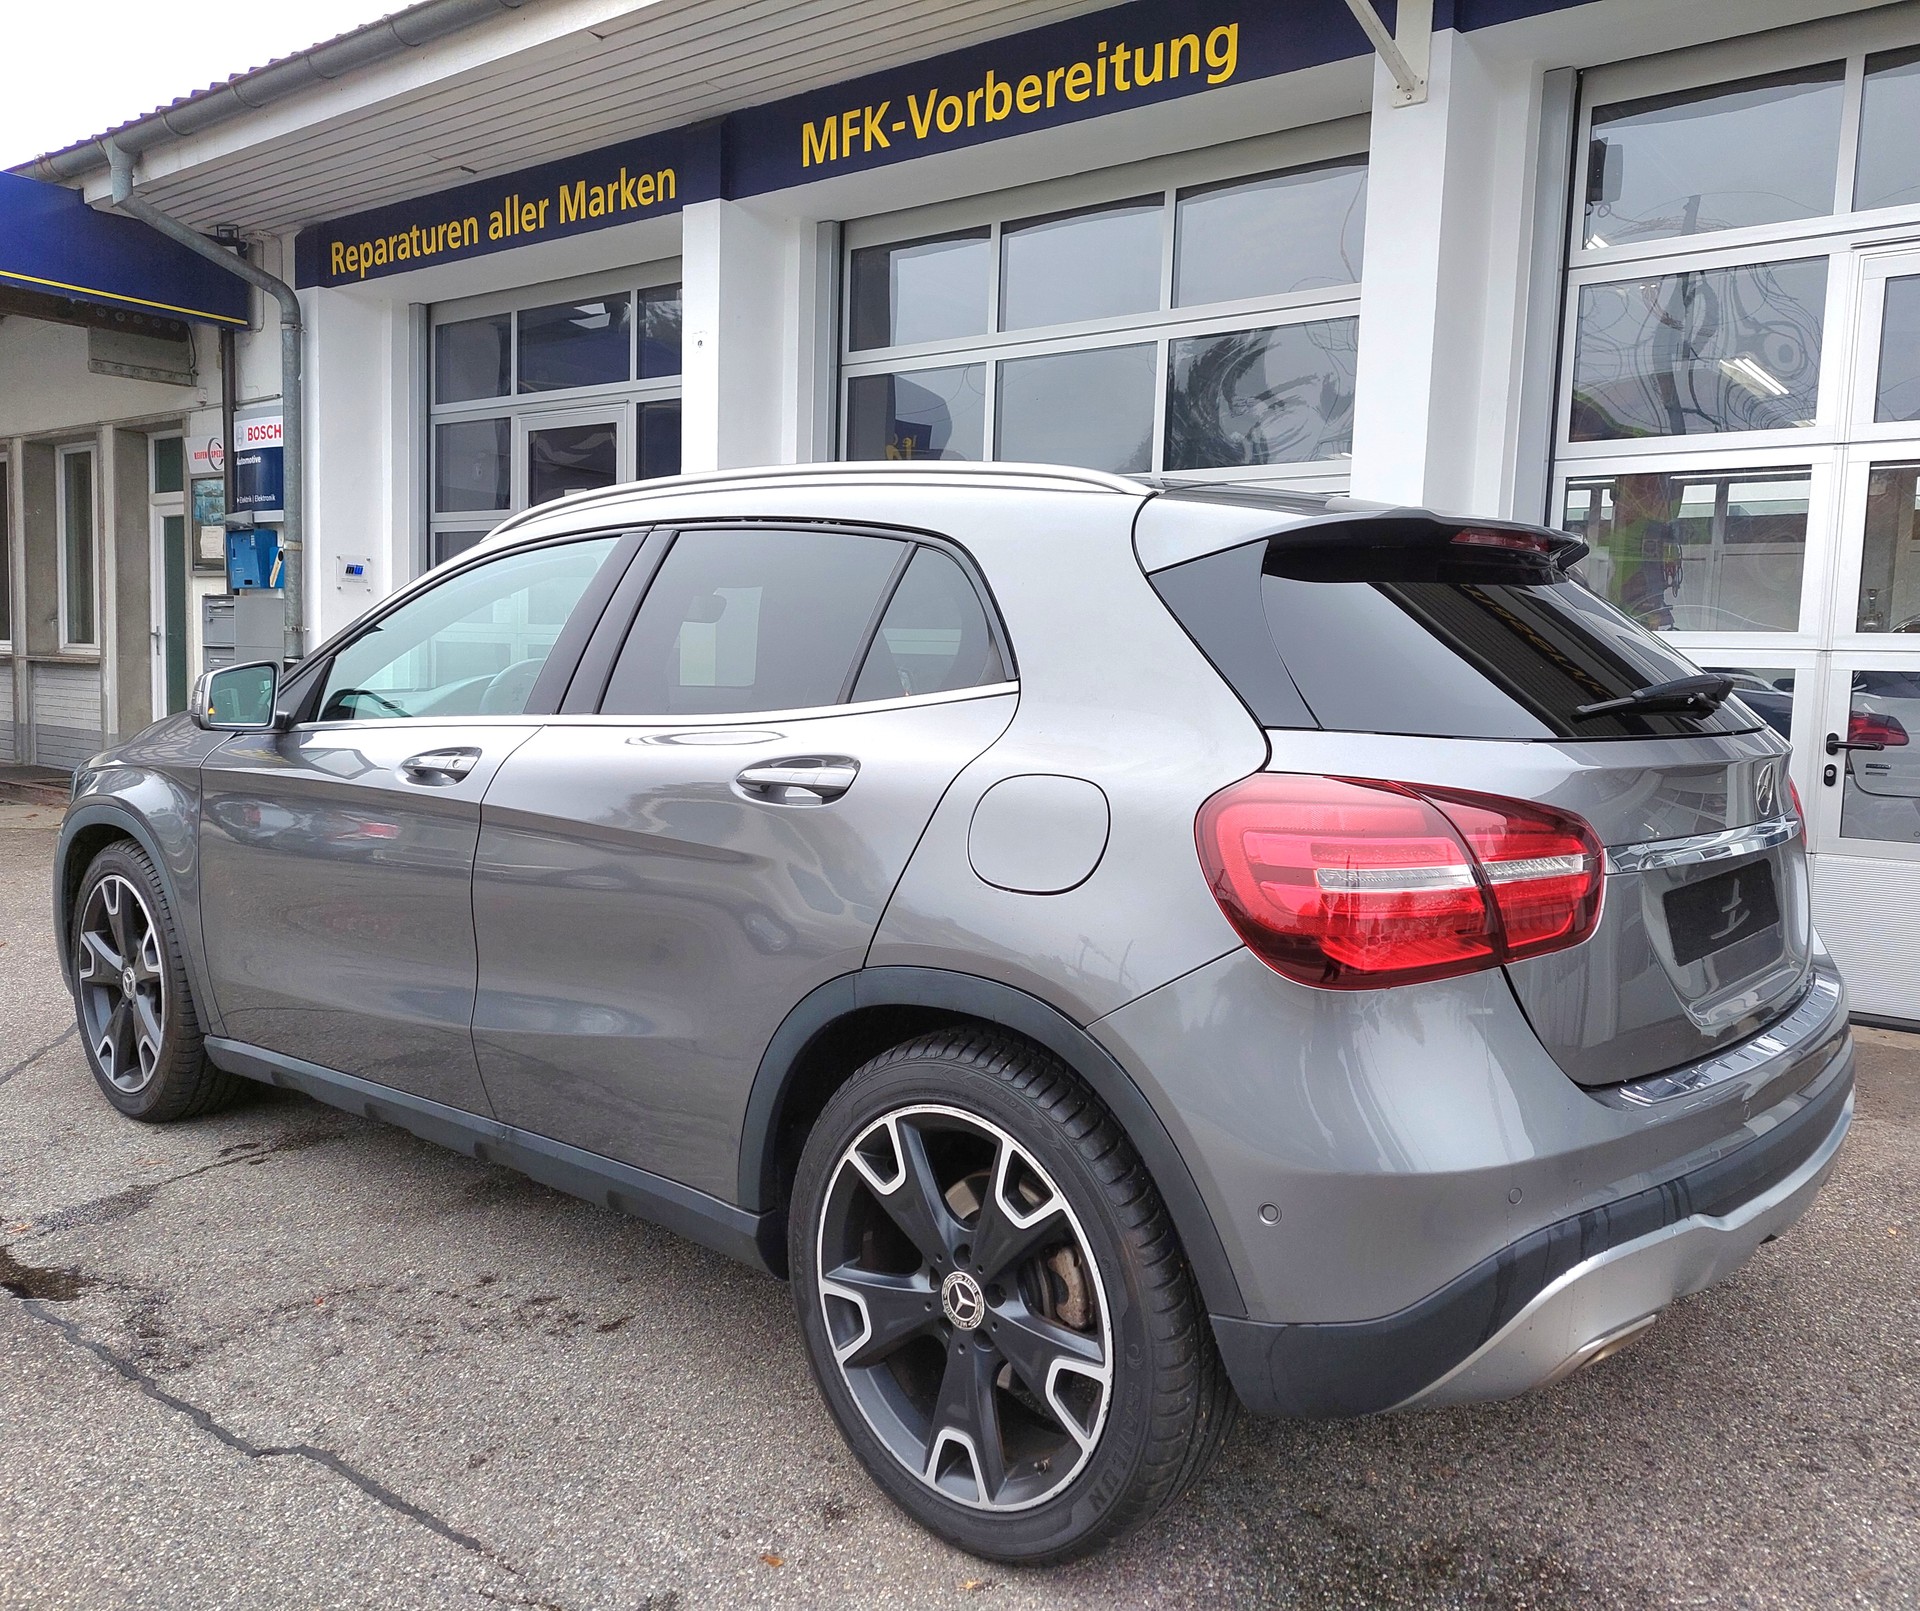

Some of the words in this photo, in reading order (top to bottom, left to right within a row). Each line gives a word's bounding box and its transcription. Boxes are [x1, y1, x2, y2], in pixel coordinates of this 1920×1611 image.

[802, 22, 1239, 168] MFK-Vorbereitung
[330, 216, 479, 279] Reparaturen
[488, 194, 549, 241] aller
[559, 167, 676, 225] Marken
[248, 424, 282, 441] BOSCH
[237, 455, 262, 466] Automotive
[254, 494, 276, 503] Elektronik
